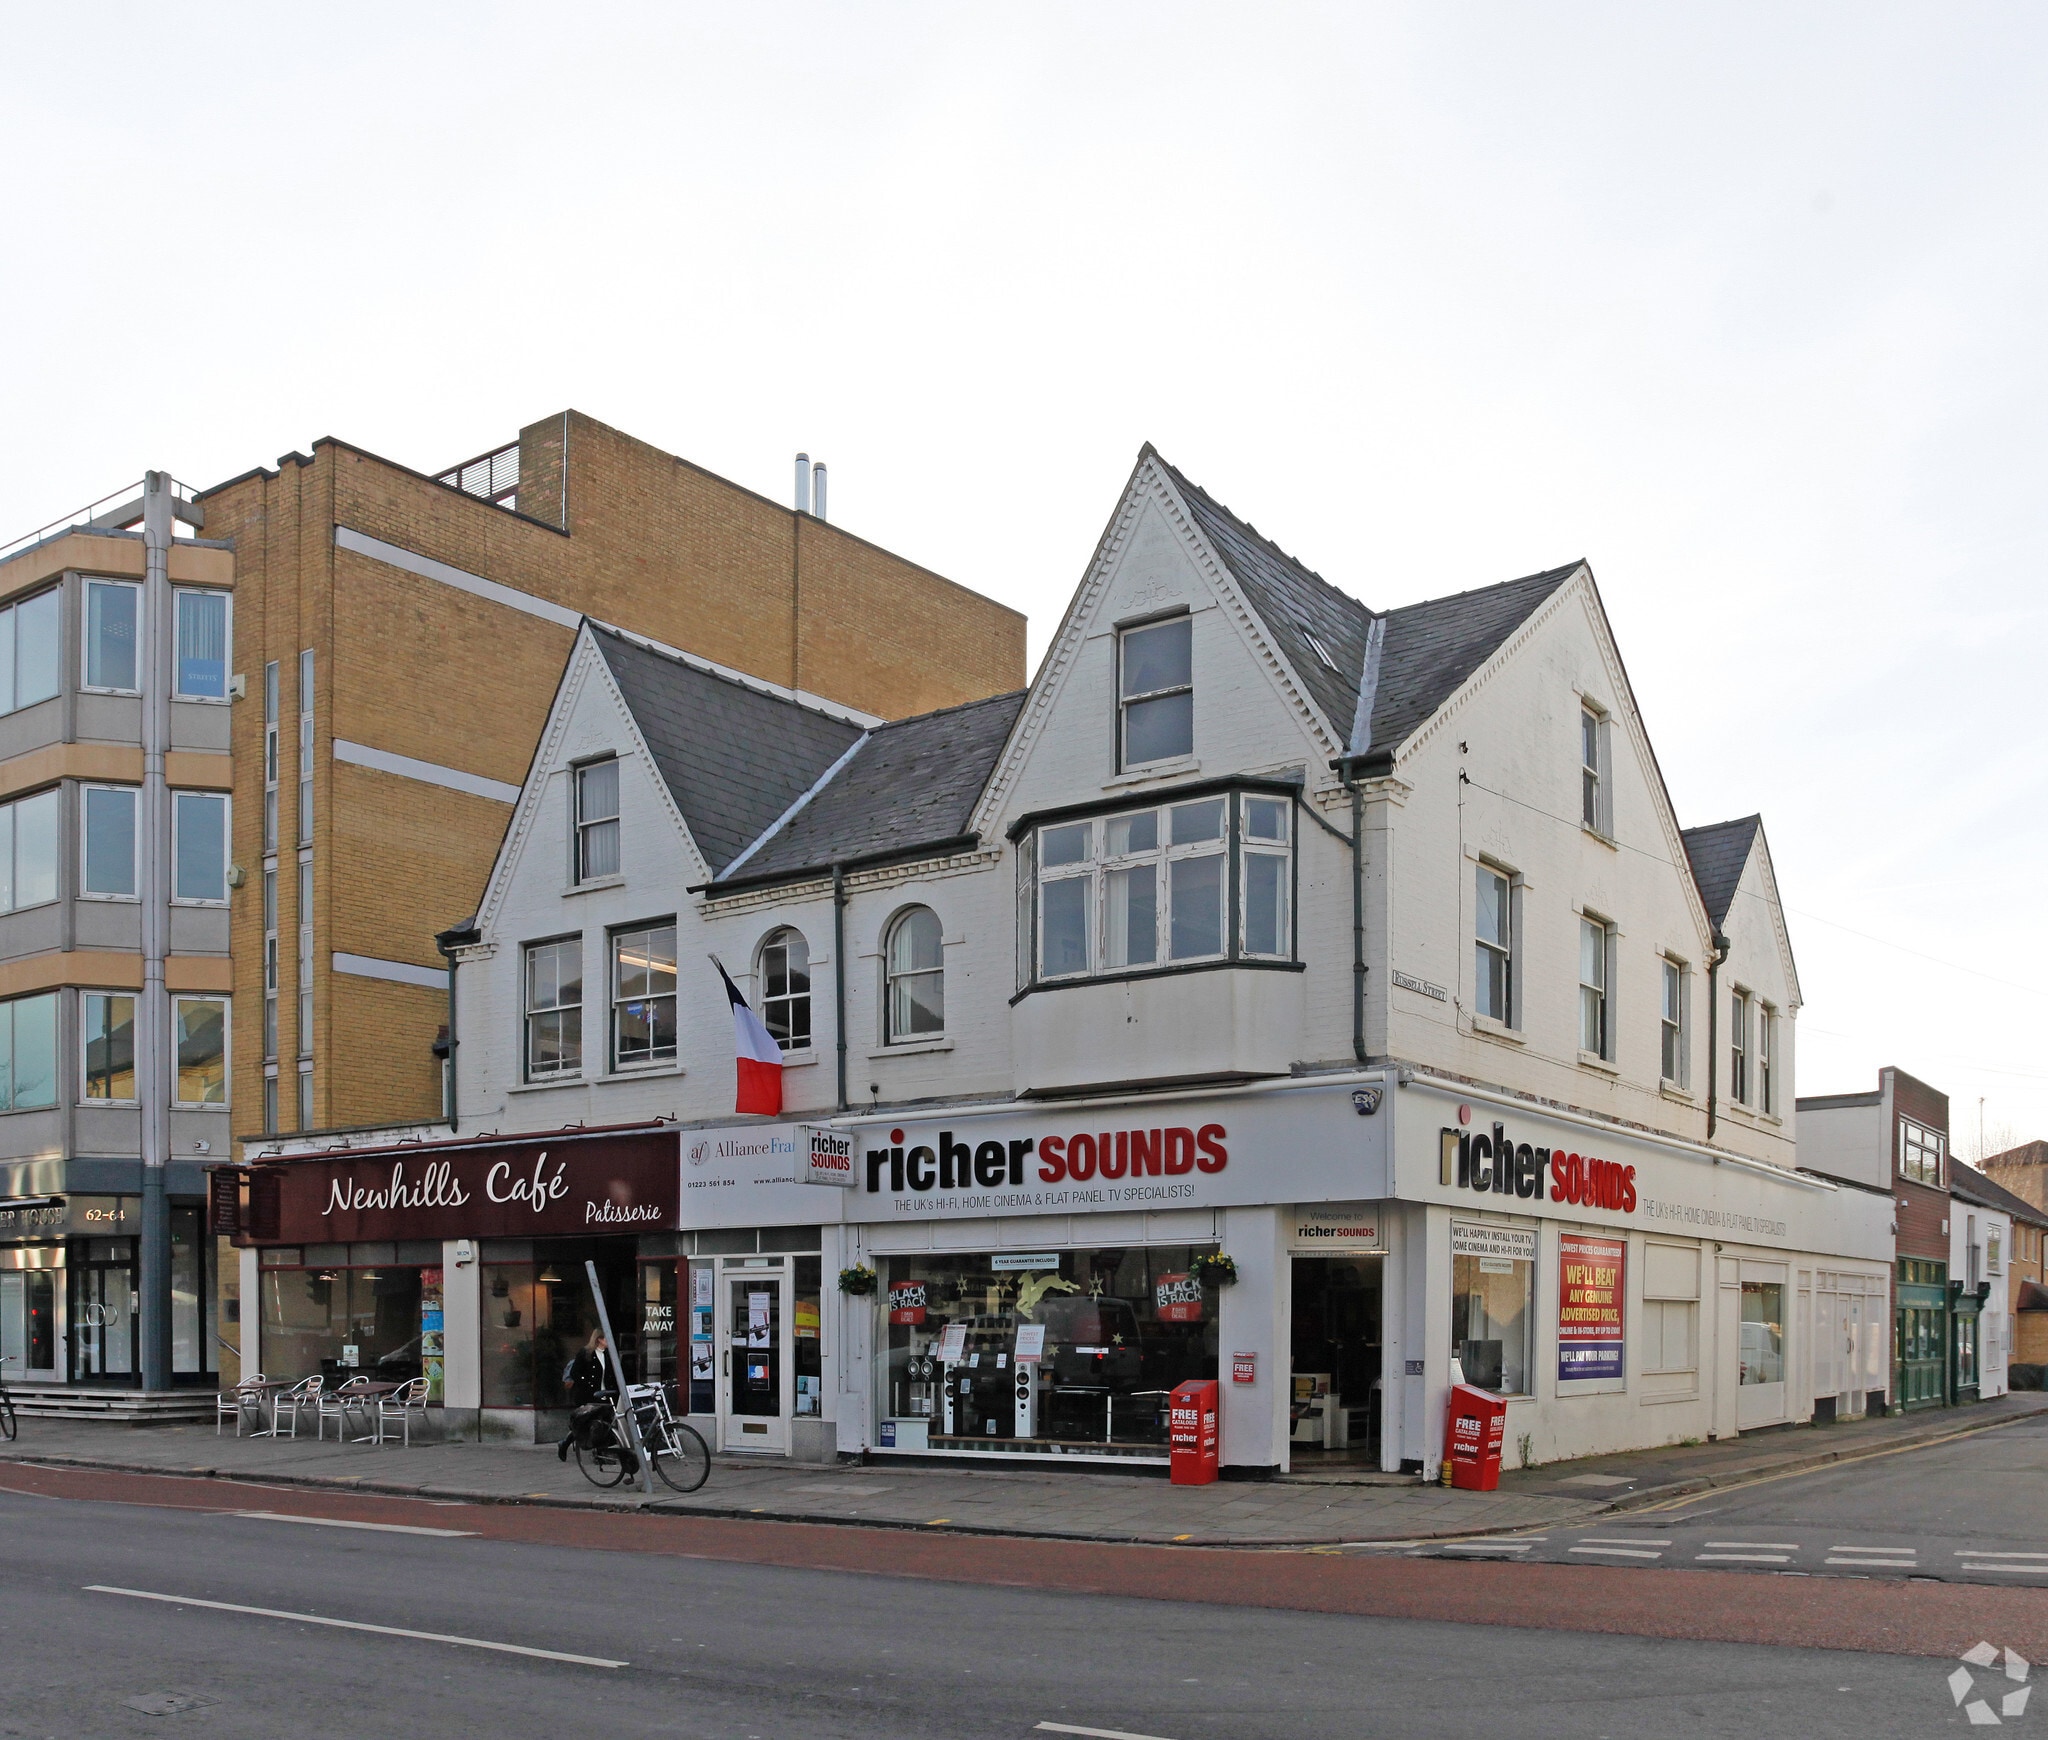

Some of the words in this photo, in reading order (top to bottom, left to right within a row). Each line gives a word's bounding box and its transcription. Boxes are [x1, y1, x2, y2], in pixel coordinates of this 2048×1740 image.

[811, 1131, 850, 1156] richer
[811, 1152, 850, 1171] SOUNDS
[322, 1161, 470, 1216] Newhills
[486, 1152, 569, 1212] Café
[688, 1180, 707, 1188] 01223
[709, 1180, 720, 1188] 561
[723, 1179, 736, 1187] 854
[894, 1199, 912, 1212] THE
[914, 1198, 934, 1212] UK's
[936, 1196, 961, 1212] HI-FI,
[962, 1196, 992, 1210] HOME
[993, 1193, 1033, 1208] CINEMA
[1035, 1193, 1042, 1206] &
[1045, 1191, 1070, 1206] FLAT
[1072, 1189, 1105, 1204] PANEL
[1108, 1188, 1122, 1202] TV
[1124, 1185, 1196, 1201] SPECIALISTS!
[1643, 1198, 1654, 1216] THE
[21, 1207, 64, 1226] HOUSE
[86, 1208, 126, 1222] 62-64
[585, 1200, 662, 1224] Patisserie
[1310, 1212, 1350, 1222] Welcome
[1352, 1212, 1363, 1222] to
[1453, 1226, 1468, 1238] WE'LL
[1470, 1228, 1490, 1240] HAPPILY
[1492, 1232, 1510, 1242] INSTALL
[1511, 1234, 1524, 1244] YOUR
[1468, 1242, 1488, 1253] CINEMA
[1489, 1244, 1500, 1254] AND
[1566, 1264, 1593, 1286] WE'LL
[1596, 1267, 1616, 1286] BEAT
[888, 1285, 926, 1302] BLACK
[1156, 1278, 1201, 1297] BLACK
[1570, 1289, 1583, 1303] ANY
[889, 1301, 898, 1312] IS
[900, 1296, 926, 1308] BACK
[1158, 1296, 1168, 1308] IS
[1170, 1290, 1202, 1304] BACK
[645, 1306, 672, 1316] TAKE
[1560, 1308, 1600, 1322] ADVERTISED
[642, 1320, 674, 1332] AWAY
[1234, 1364, 1253, 1372] FREE
[1172, 1408, 1198, 1420] FREE
[1456, 1418, 1481, 1431] FREE
